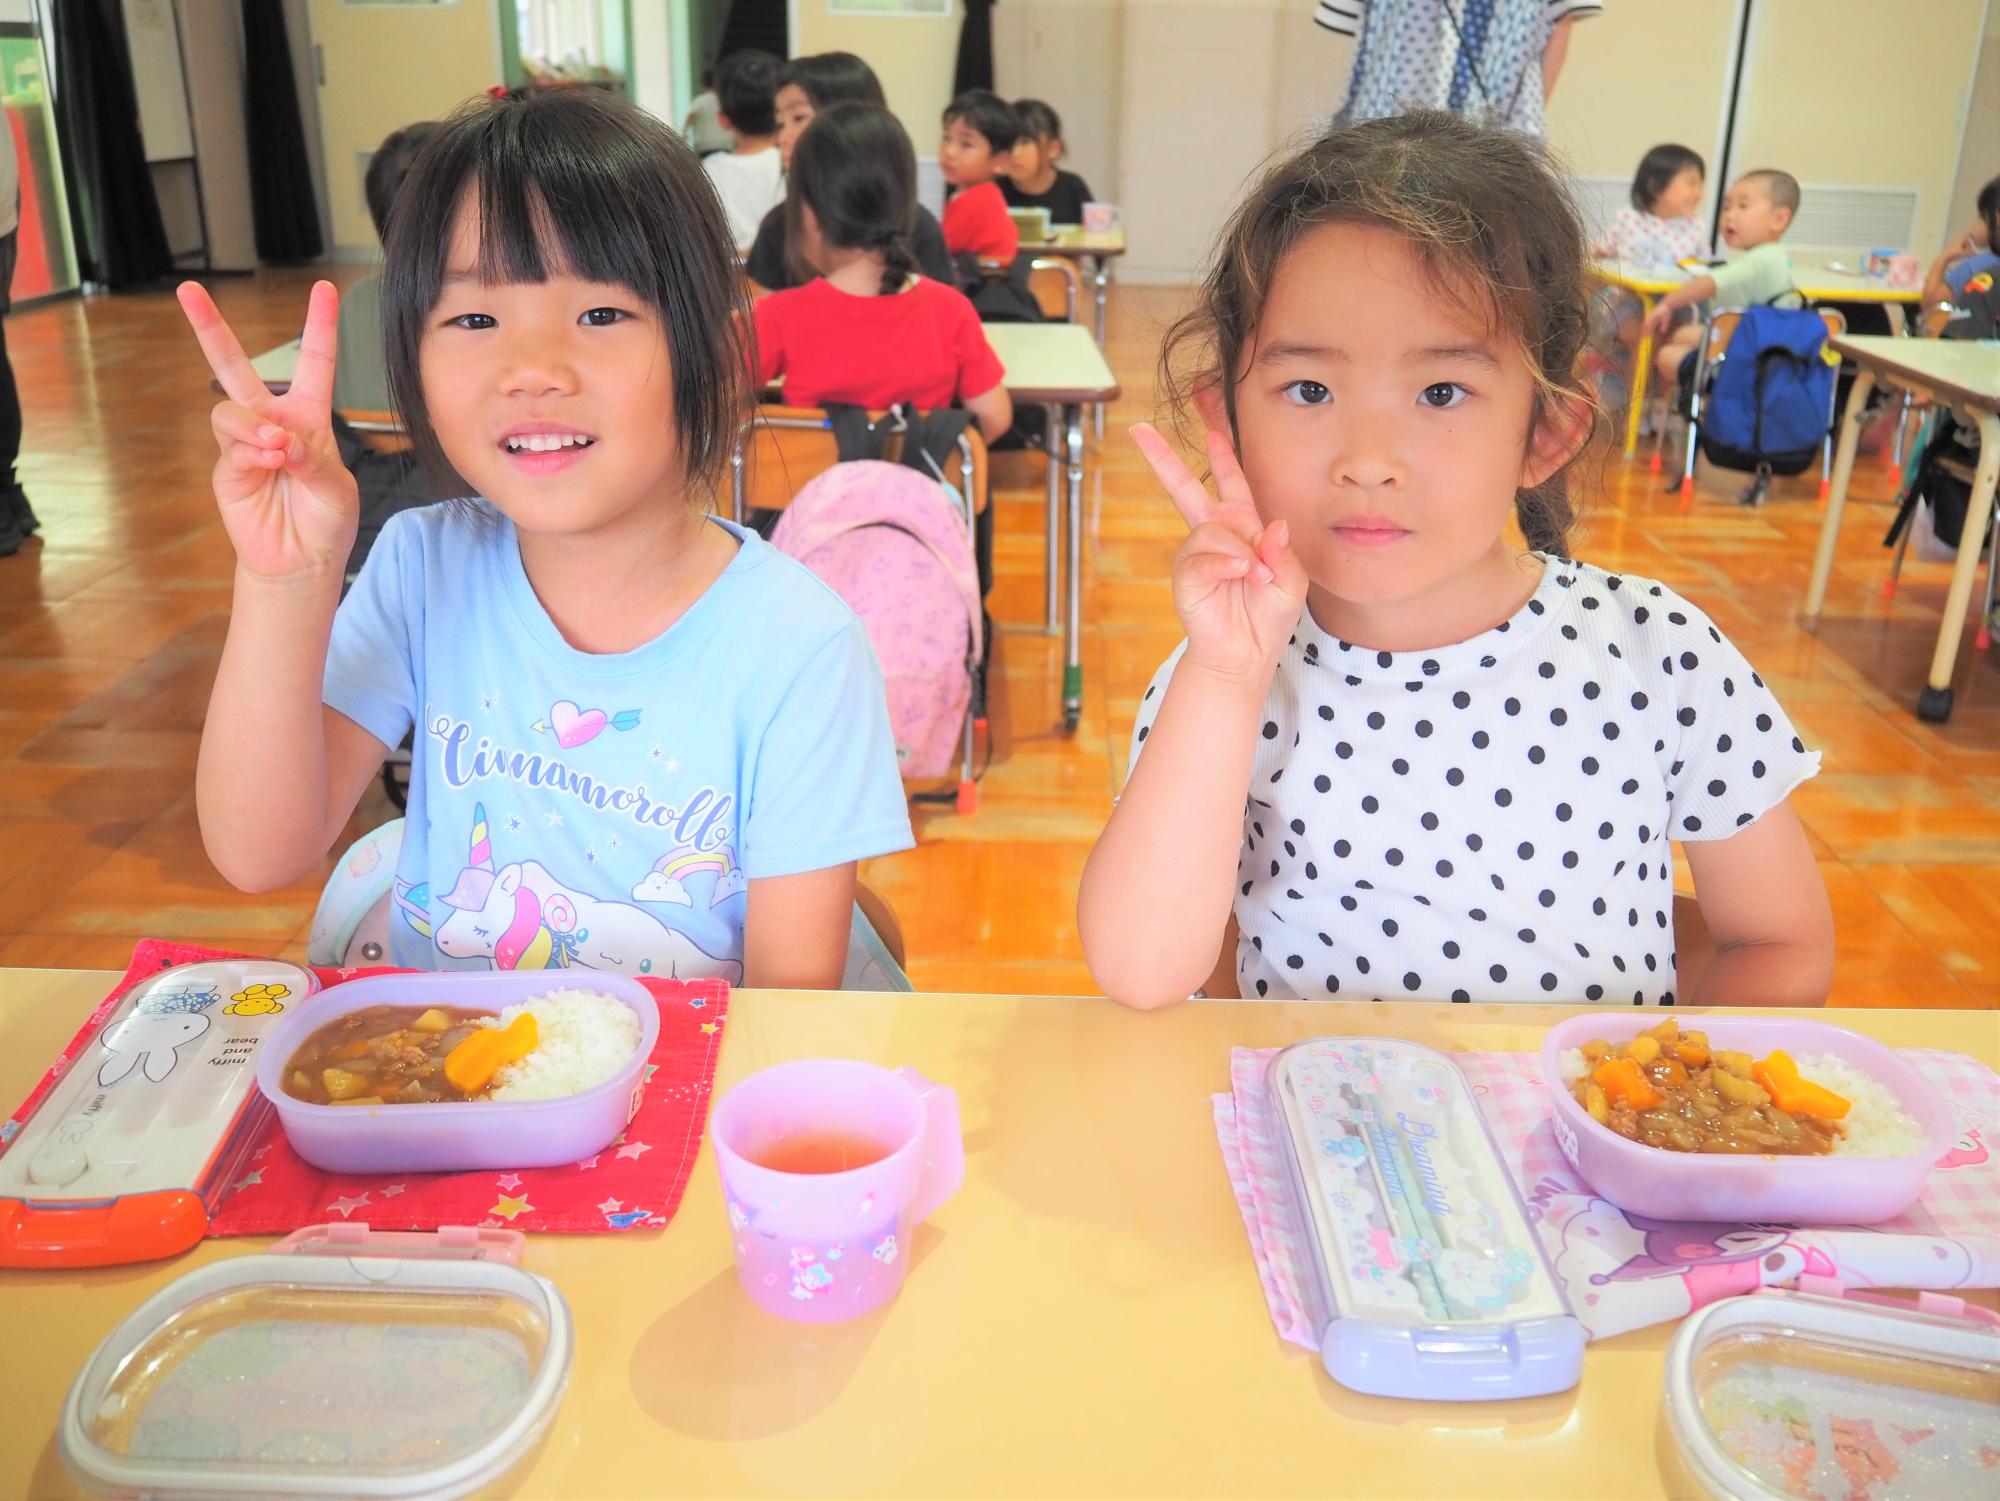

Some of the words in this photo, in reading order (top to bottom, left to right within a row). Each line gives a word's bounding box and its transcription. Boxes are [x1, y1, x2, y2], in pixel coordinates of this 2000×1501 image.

[222, 1037, 259, 1045] bear
[222, 1047, 253, 1055] and
[207, 1057, 247, 1066] miffy
[1396, 1112, 1452, 1216] Dreaming
